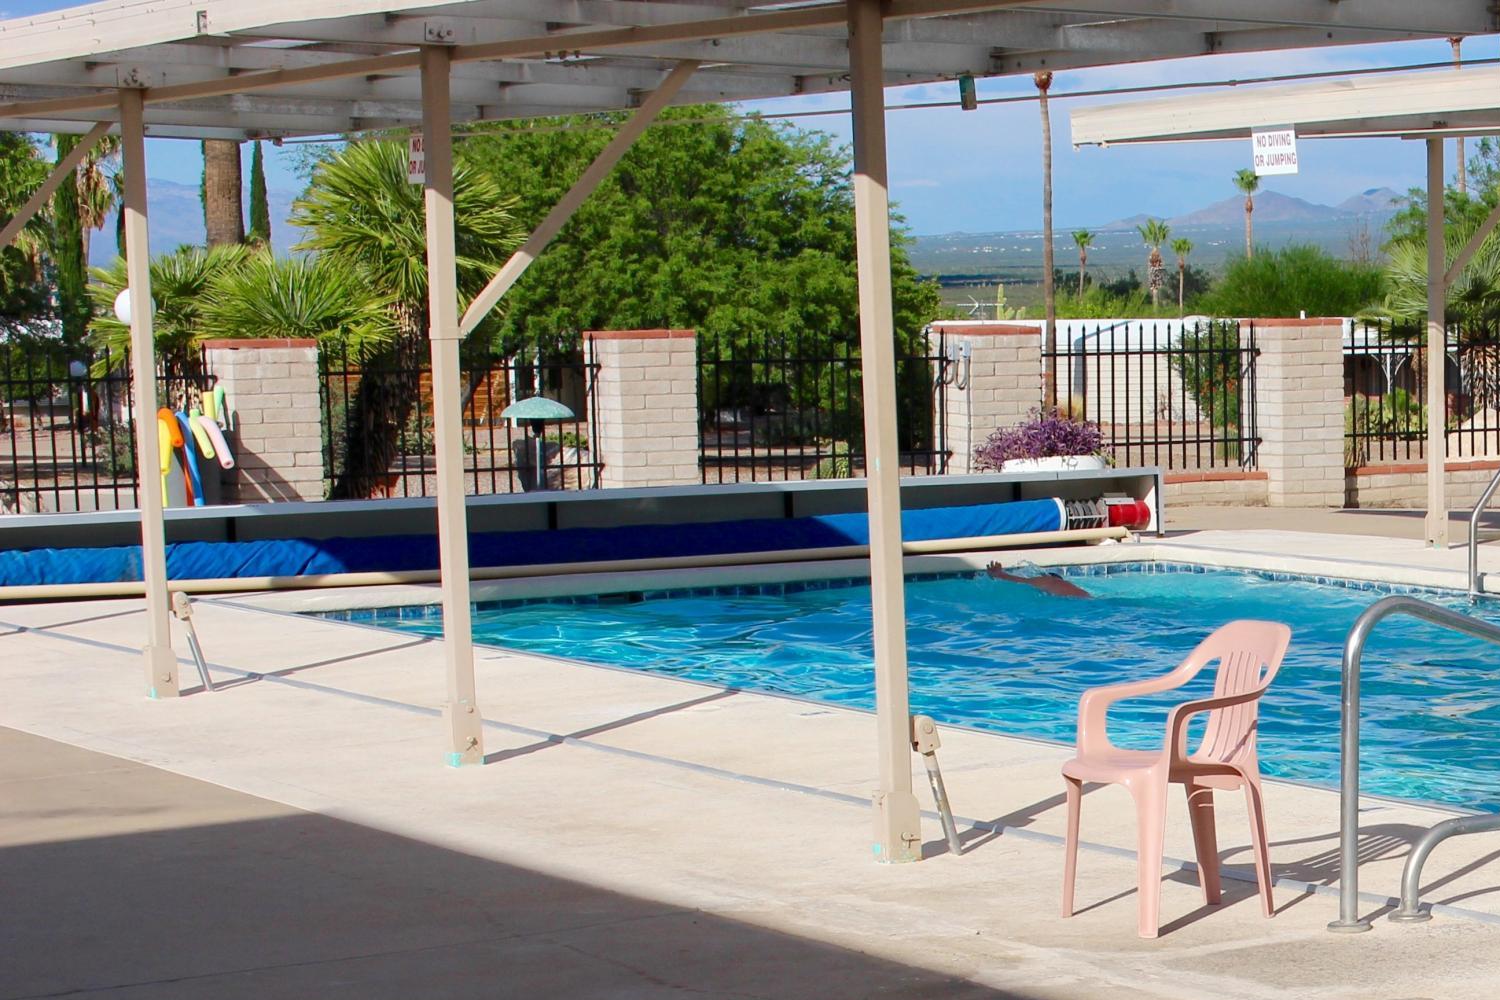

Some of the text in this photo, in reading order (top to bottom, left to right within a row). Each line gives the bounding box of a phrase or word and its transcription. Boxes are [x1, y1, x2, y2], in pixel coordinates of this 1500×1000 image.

[1256, 133, 1291, 147] NO DIVING
[1255, 152, 1297, 167] OR JUMPING
